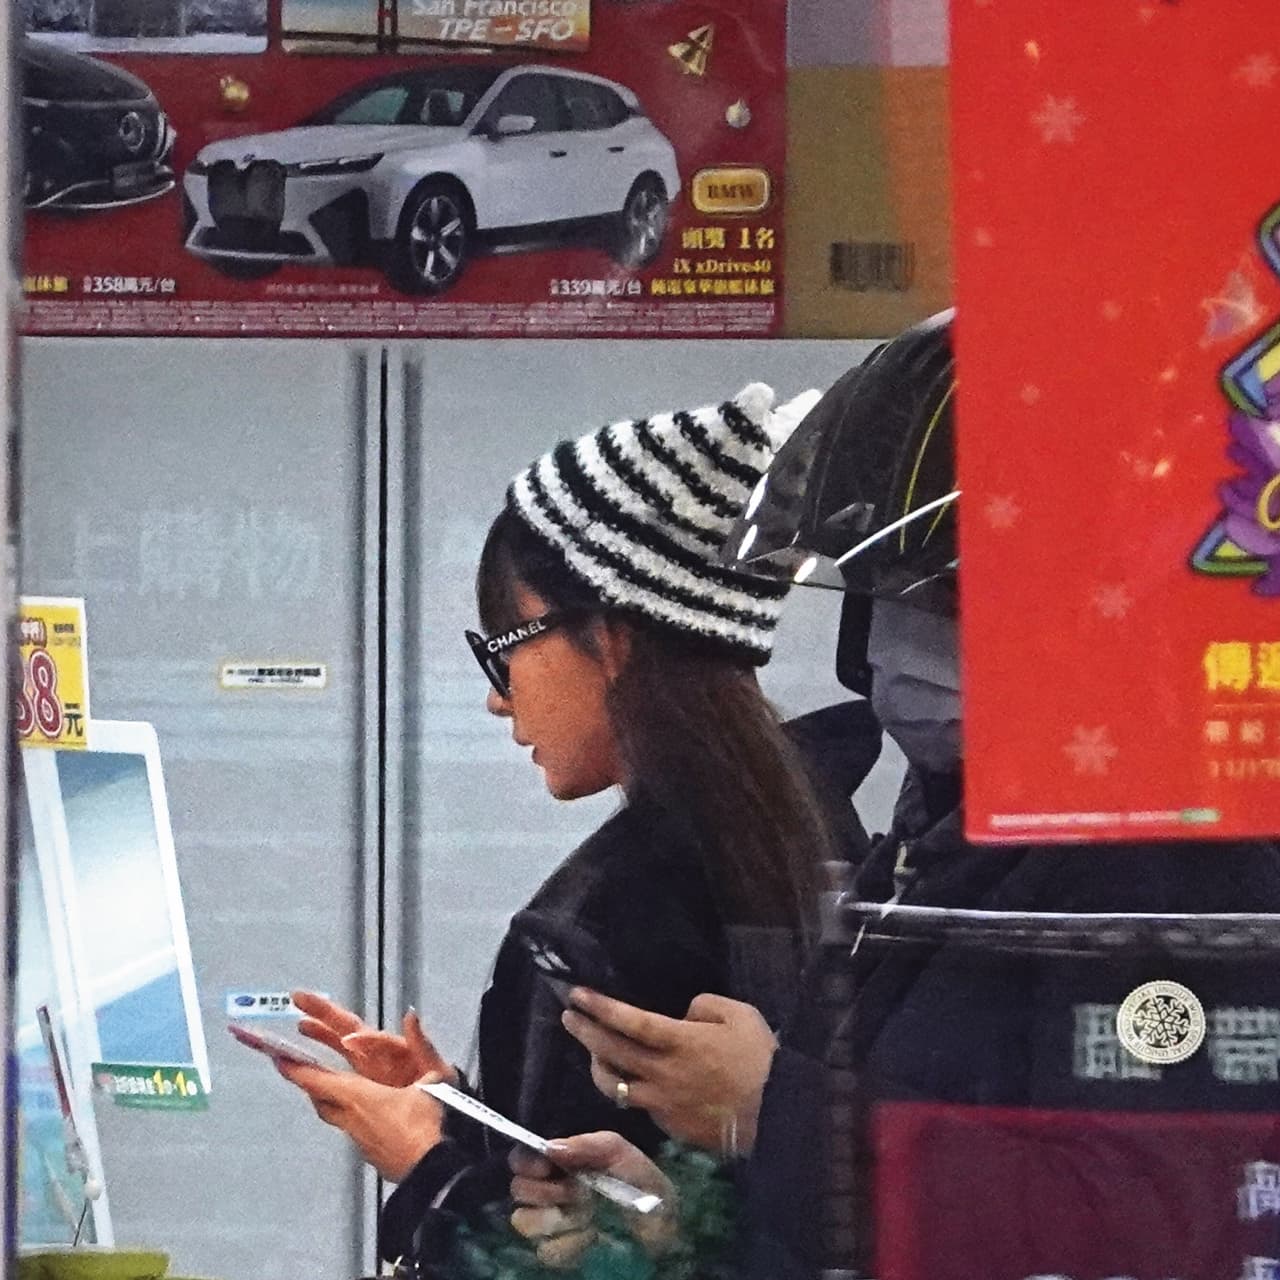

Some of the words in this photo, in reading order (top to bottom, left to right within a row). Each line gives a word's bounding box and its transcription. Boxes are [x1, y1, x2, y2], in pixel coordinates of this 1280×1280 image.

[438, 18, 488, 40] TPE
[515, 18, 573, 41] SFO
[487, 620, 547, 653] CHANEL
